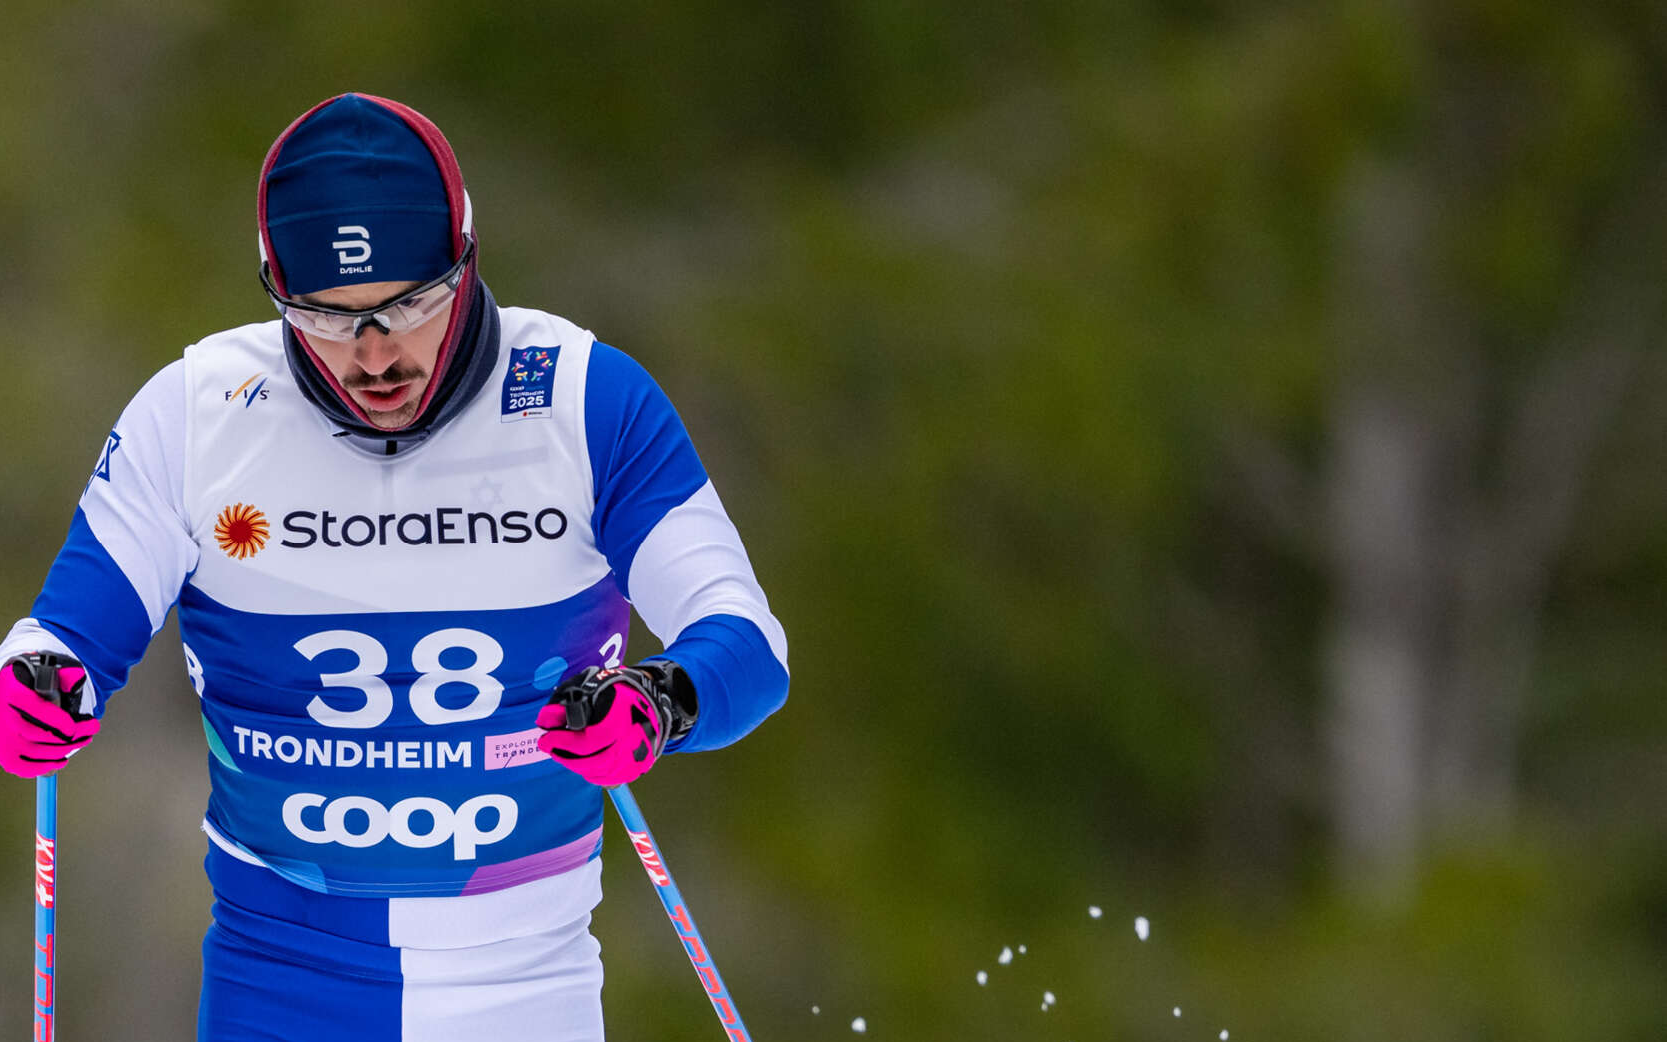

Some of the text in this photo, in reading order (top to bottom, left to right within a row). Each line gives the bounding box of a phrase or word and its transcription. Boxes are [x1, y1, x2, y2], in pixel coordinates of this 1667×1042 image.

[509, 395, 544, 409] 2025
[280, 507, 568, 549] StoraEnso
[293, 627, 505, 729] 38
[233, 726, 472, 769] TRONDHEIM
[282, 792, 519, 861] coop
